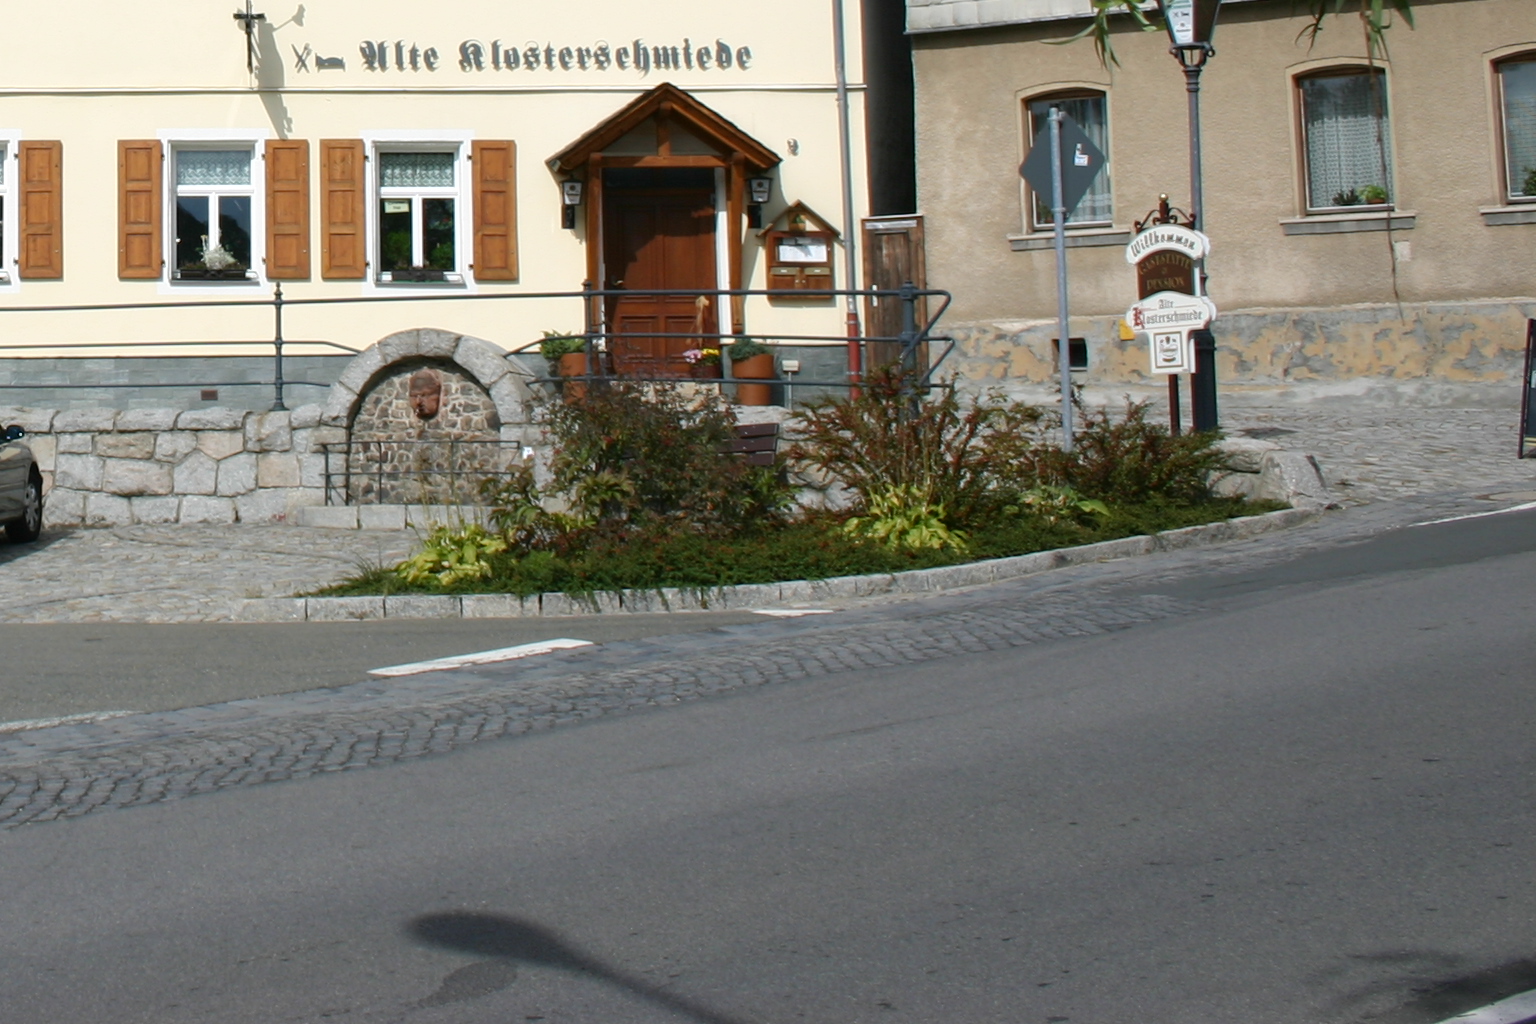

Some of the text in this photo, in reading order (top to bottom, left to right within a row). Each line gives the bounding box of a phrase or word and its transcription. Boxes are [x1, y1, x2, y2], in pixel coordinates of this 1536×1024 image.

[359, 38, 752, 79] Alte Klosterschmiede
[1130, 231, 1196, 258] Willkommen
[1132, 307, 1202, 329] Klosterschmiede
